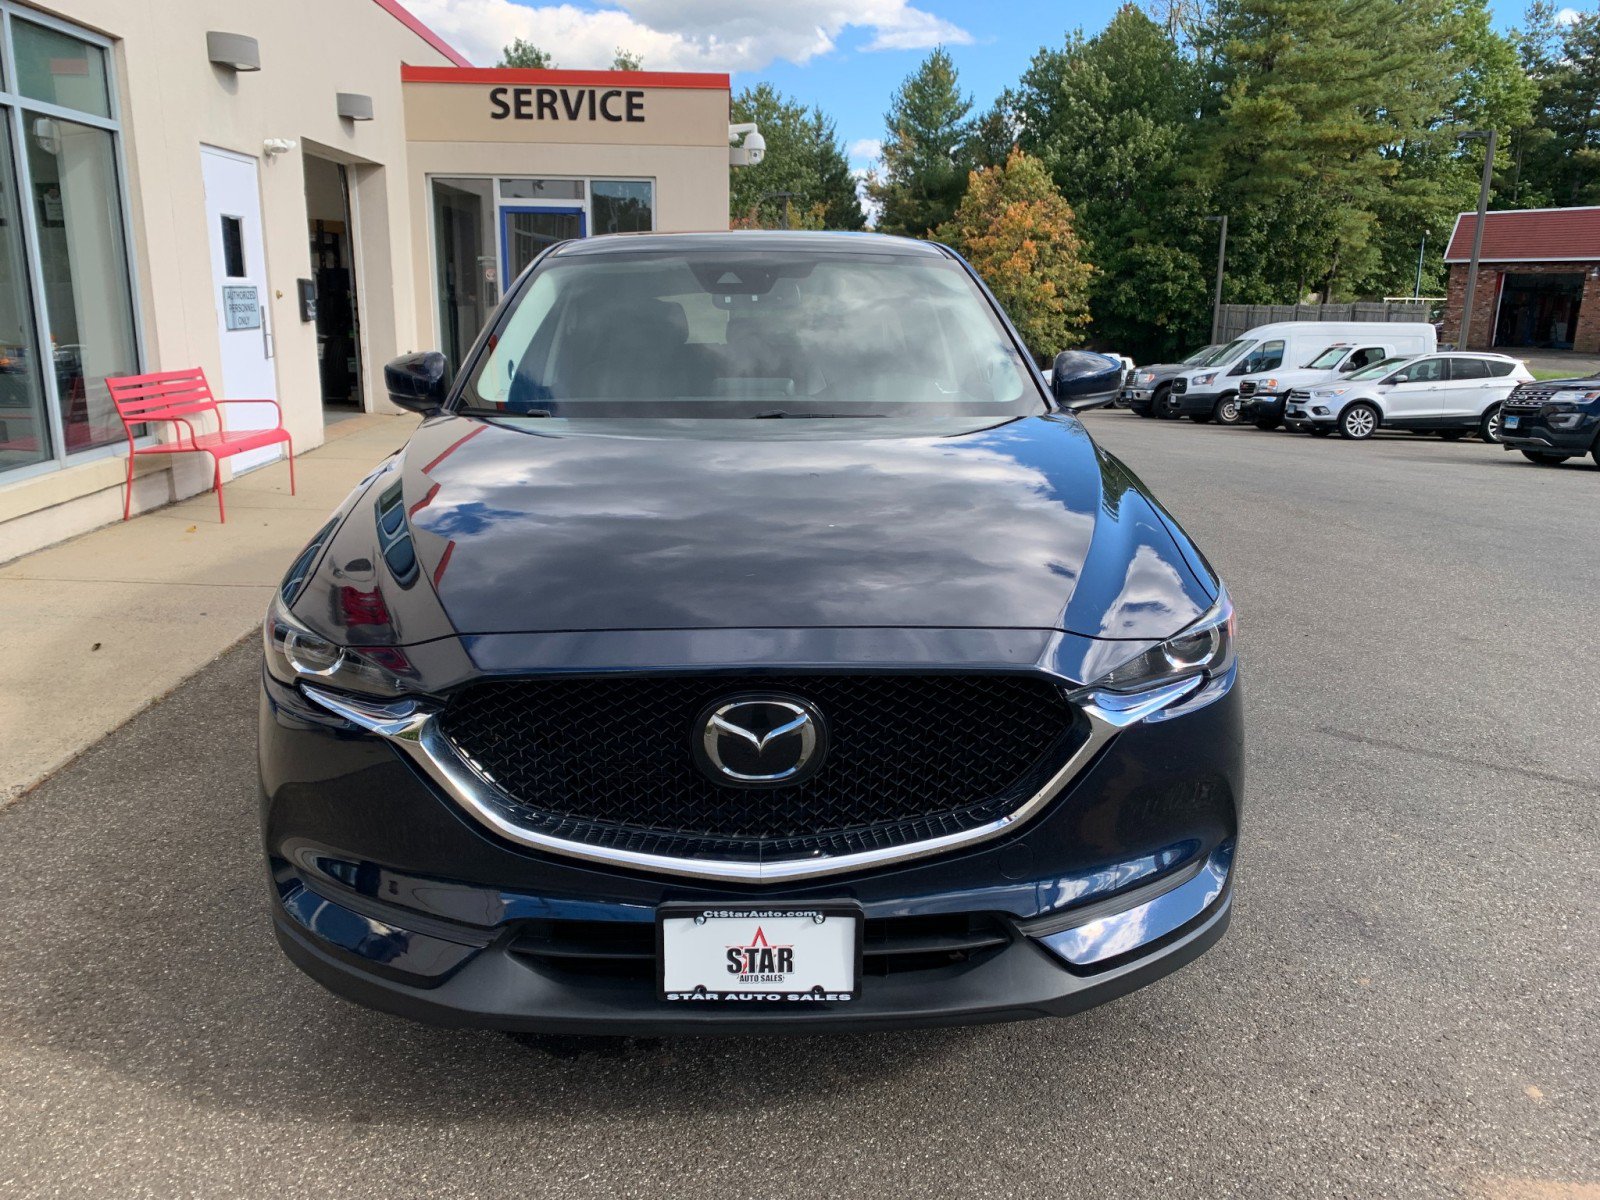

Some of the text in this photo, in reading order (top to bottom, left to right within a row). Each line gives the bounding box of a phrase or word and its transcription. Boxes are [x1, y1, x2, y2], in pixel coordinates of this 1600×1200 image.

[490, 87, 645, 122] SERVICE
[227, 291, 256, 300] AUTHORIZED
[229, 303, 257, 312] PERSONNEL
[237, 316, 250, 325] ONLY
[702, 910, 817, 918] CtStarAuto.com
[726, 947, 794, 974] STAR
[739, 974, 784, 982] AUTO SALES
[667, 993, 851, 1001] STAR AUTO SALES
